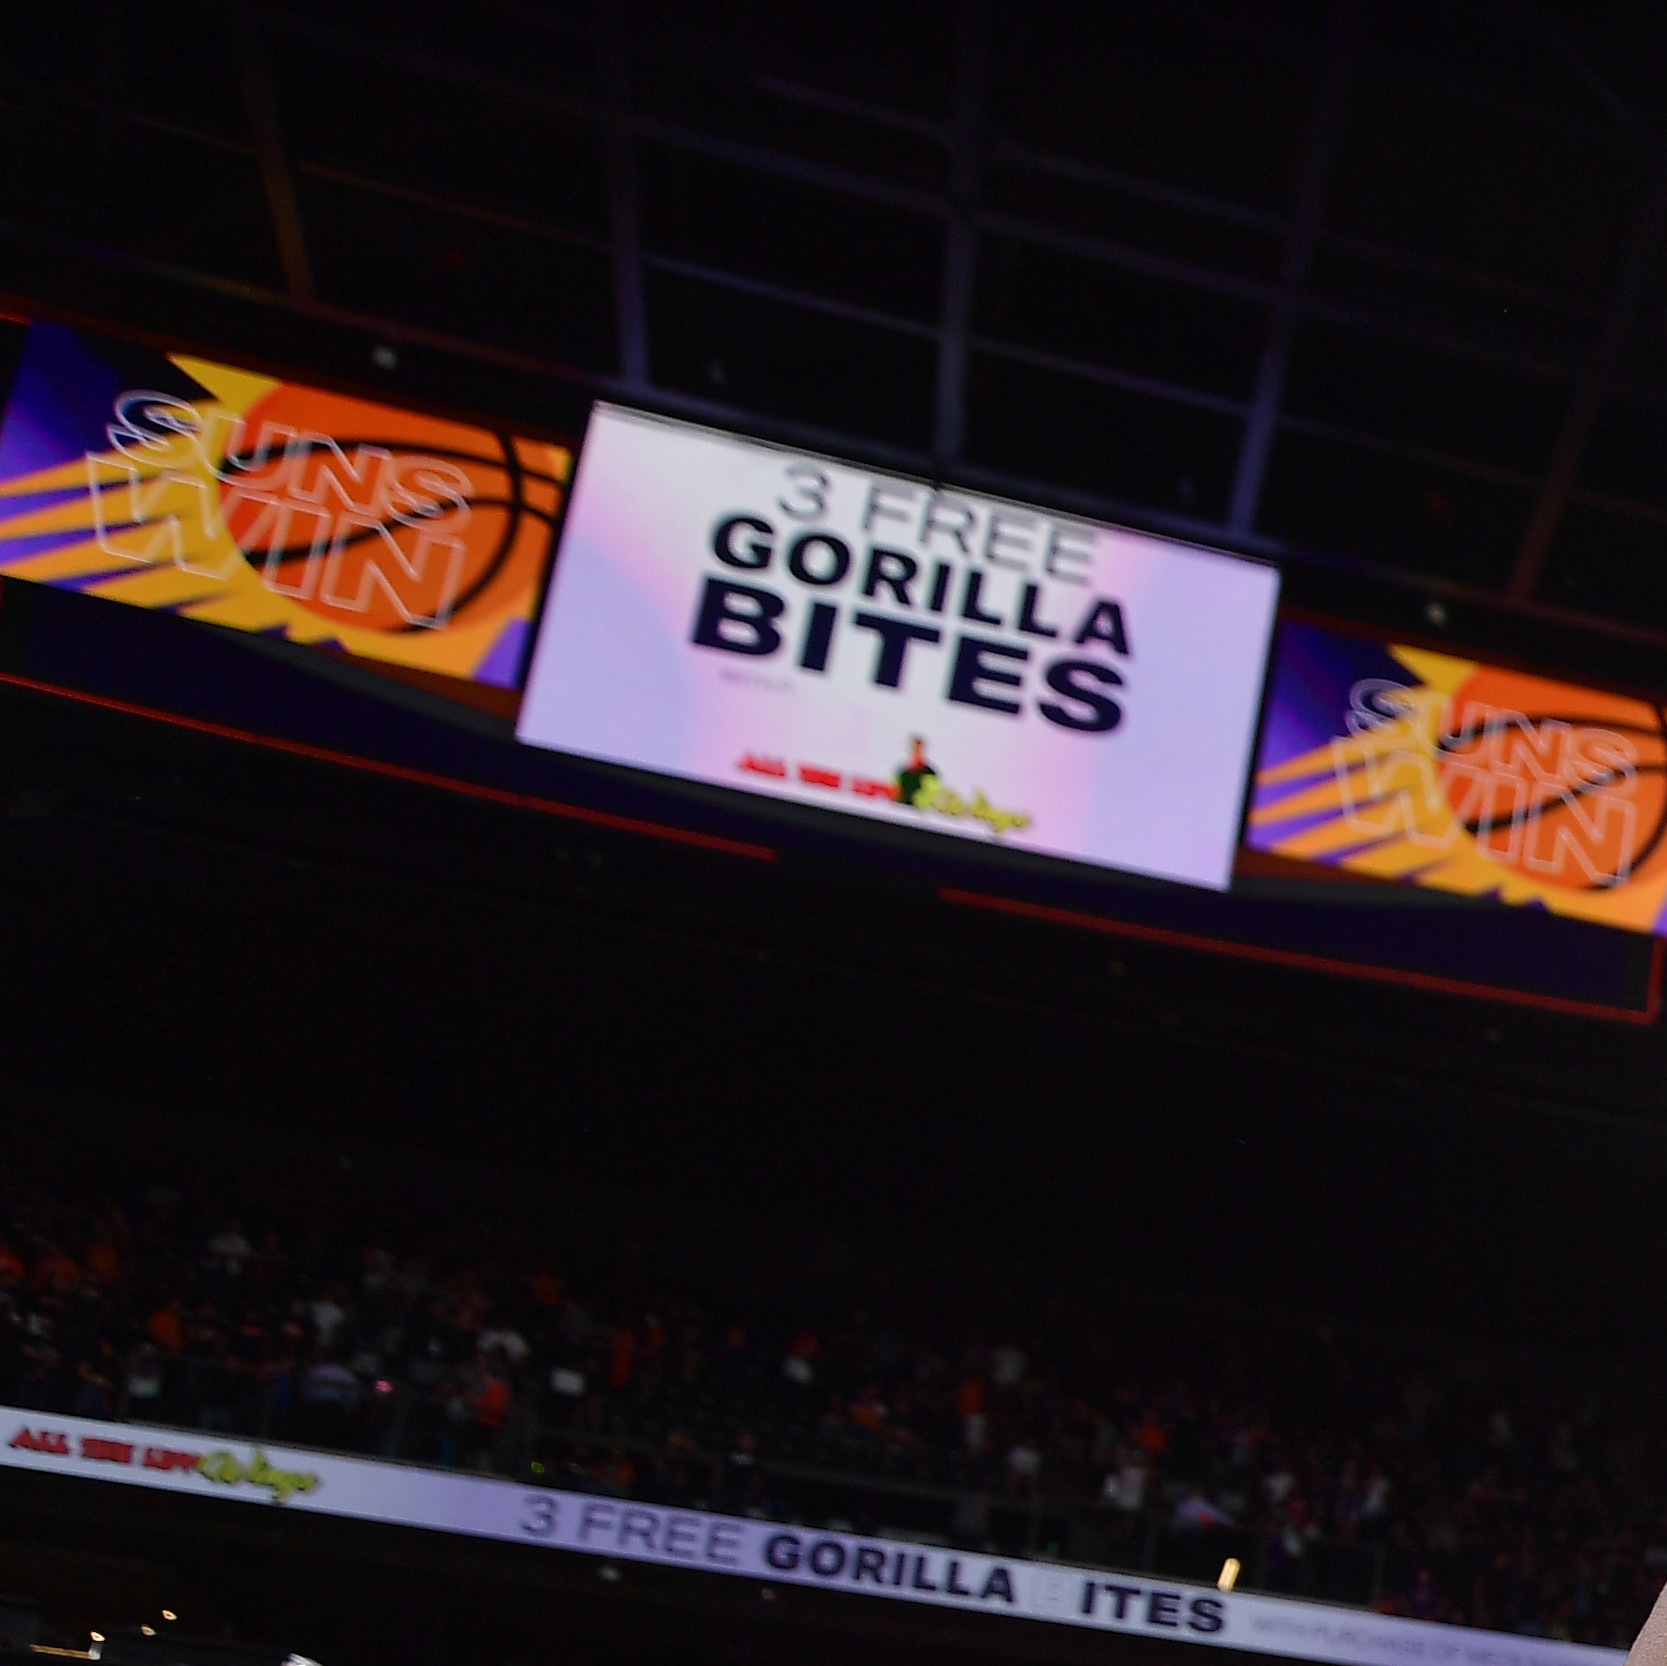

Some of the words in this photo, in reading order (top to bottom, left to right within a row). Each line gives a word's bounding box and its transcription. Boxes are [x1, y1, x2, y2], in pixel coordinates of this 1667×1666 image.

[107, 389, 475, 535] SUNS
[777, 461, 829, 521] 3
[862, 483, 1098, 585] FREE
[85, 450, 467, 630] WIN
[711, 515, 1131, 657] GORILLA
[690, 577, 1125, 735] BITES
[1344, 677, 1640, 798] SUNS
[1332, 735, 1635, 890] WIN
[519, 1495, 557, 1536] 3
[577, 1503, 742, 1564] FREE
[764, 1533, 1015, 1605] GORILLA
[1078, 1580, 1229, 1634] ITES
